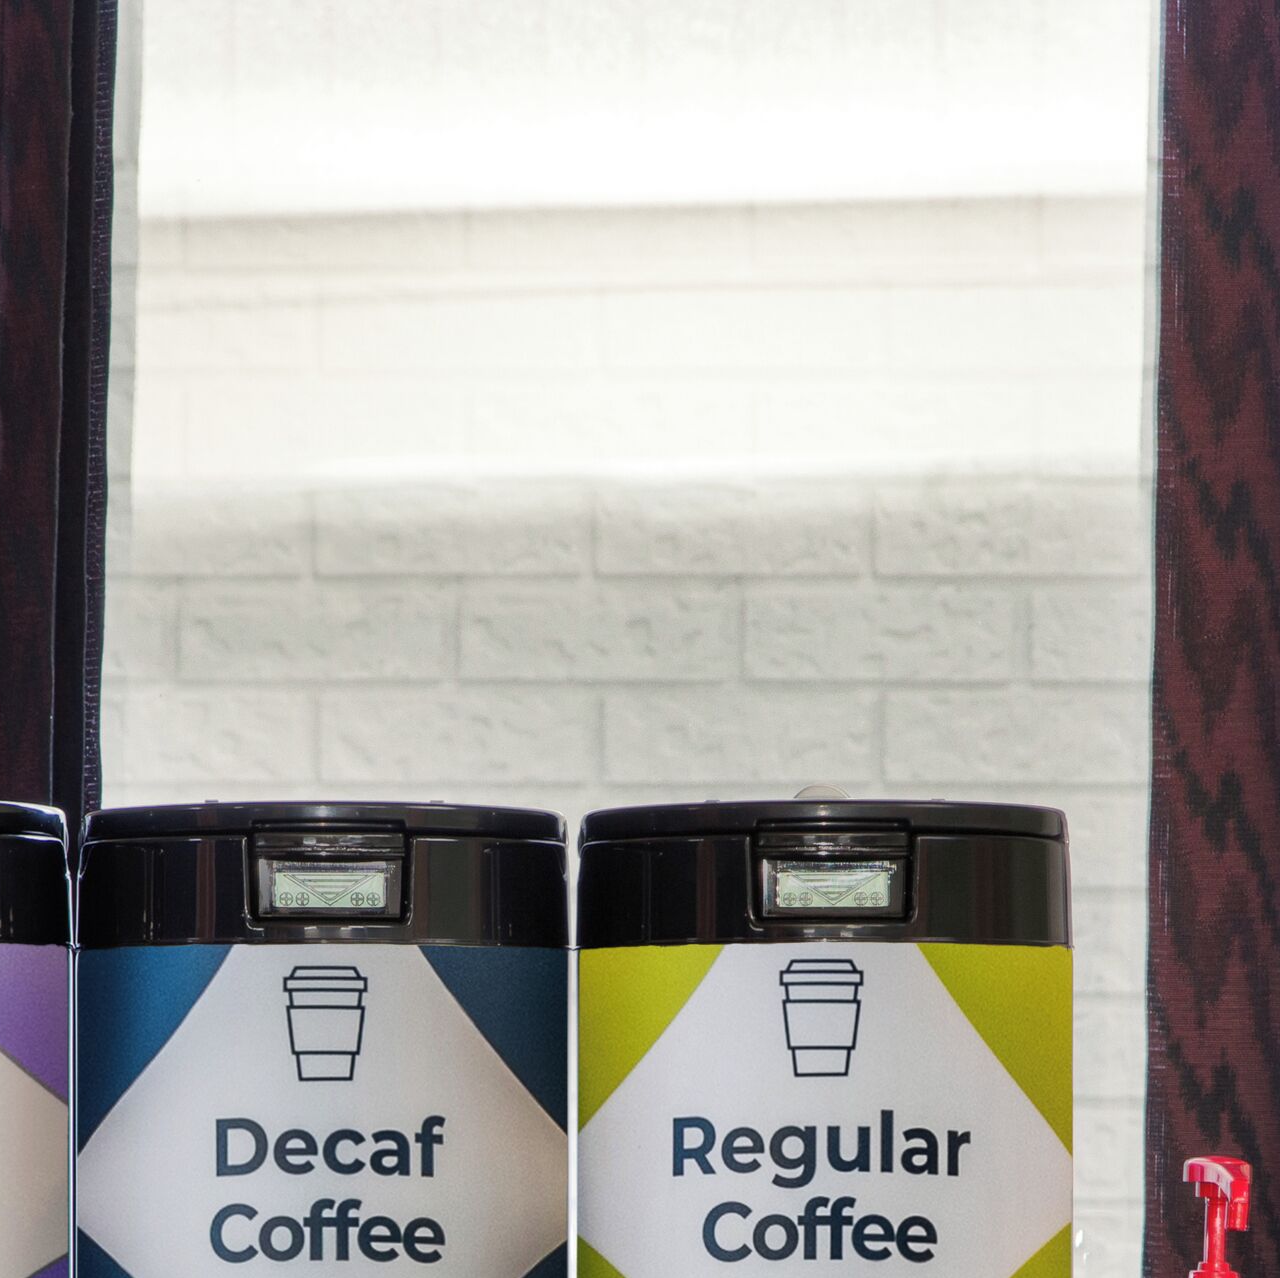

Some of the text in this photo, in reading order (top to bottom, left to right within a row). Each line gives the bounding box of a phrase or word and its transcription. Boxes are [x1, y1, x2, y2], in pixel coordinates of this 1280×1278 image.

[215, 1114, 446, 1178] Decaf
[672, 1109, 971, 1189] Regular
[209, 1198, 446, 1264] Coffee
[702, 1195, 938, 1264] Coffee
